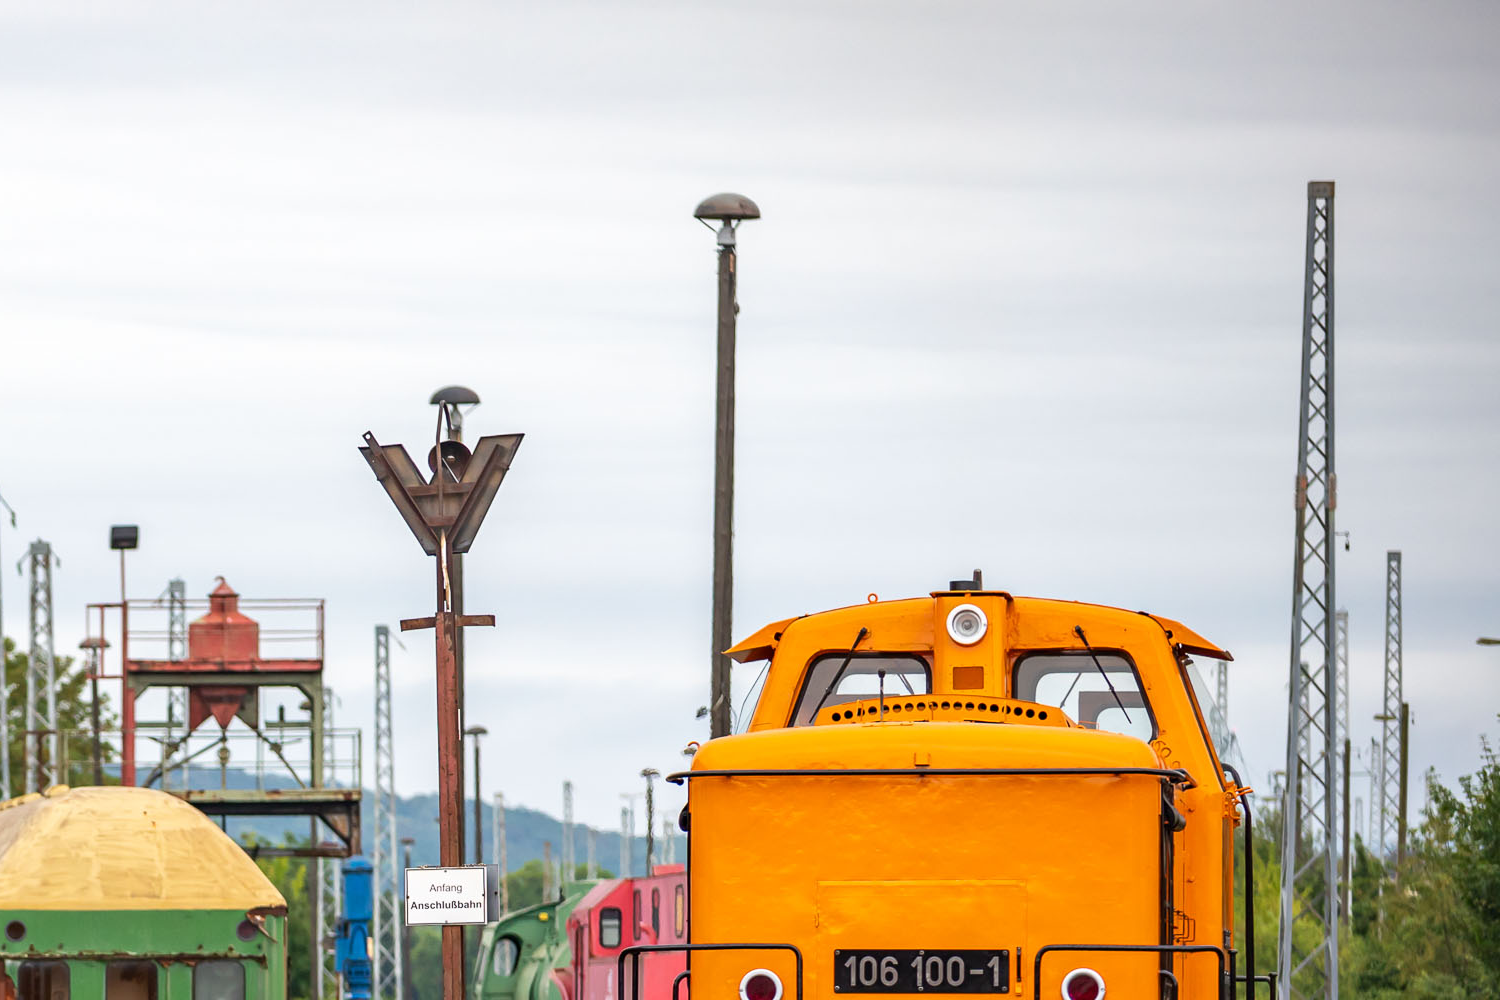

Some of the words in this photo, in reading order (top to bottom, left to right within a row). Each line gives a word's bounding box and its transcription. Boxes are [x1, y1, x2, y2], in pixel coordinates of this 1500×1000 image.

[429, 883, 463, 894] Anfang
[410, 900, 482, 910] Anschlußbahn
[844, 955, 899, 987] 106
[910, 955, 1000, 987] 100-1
